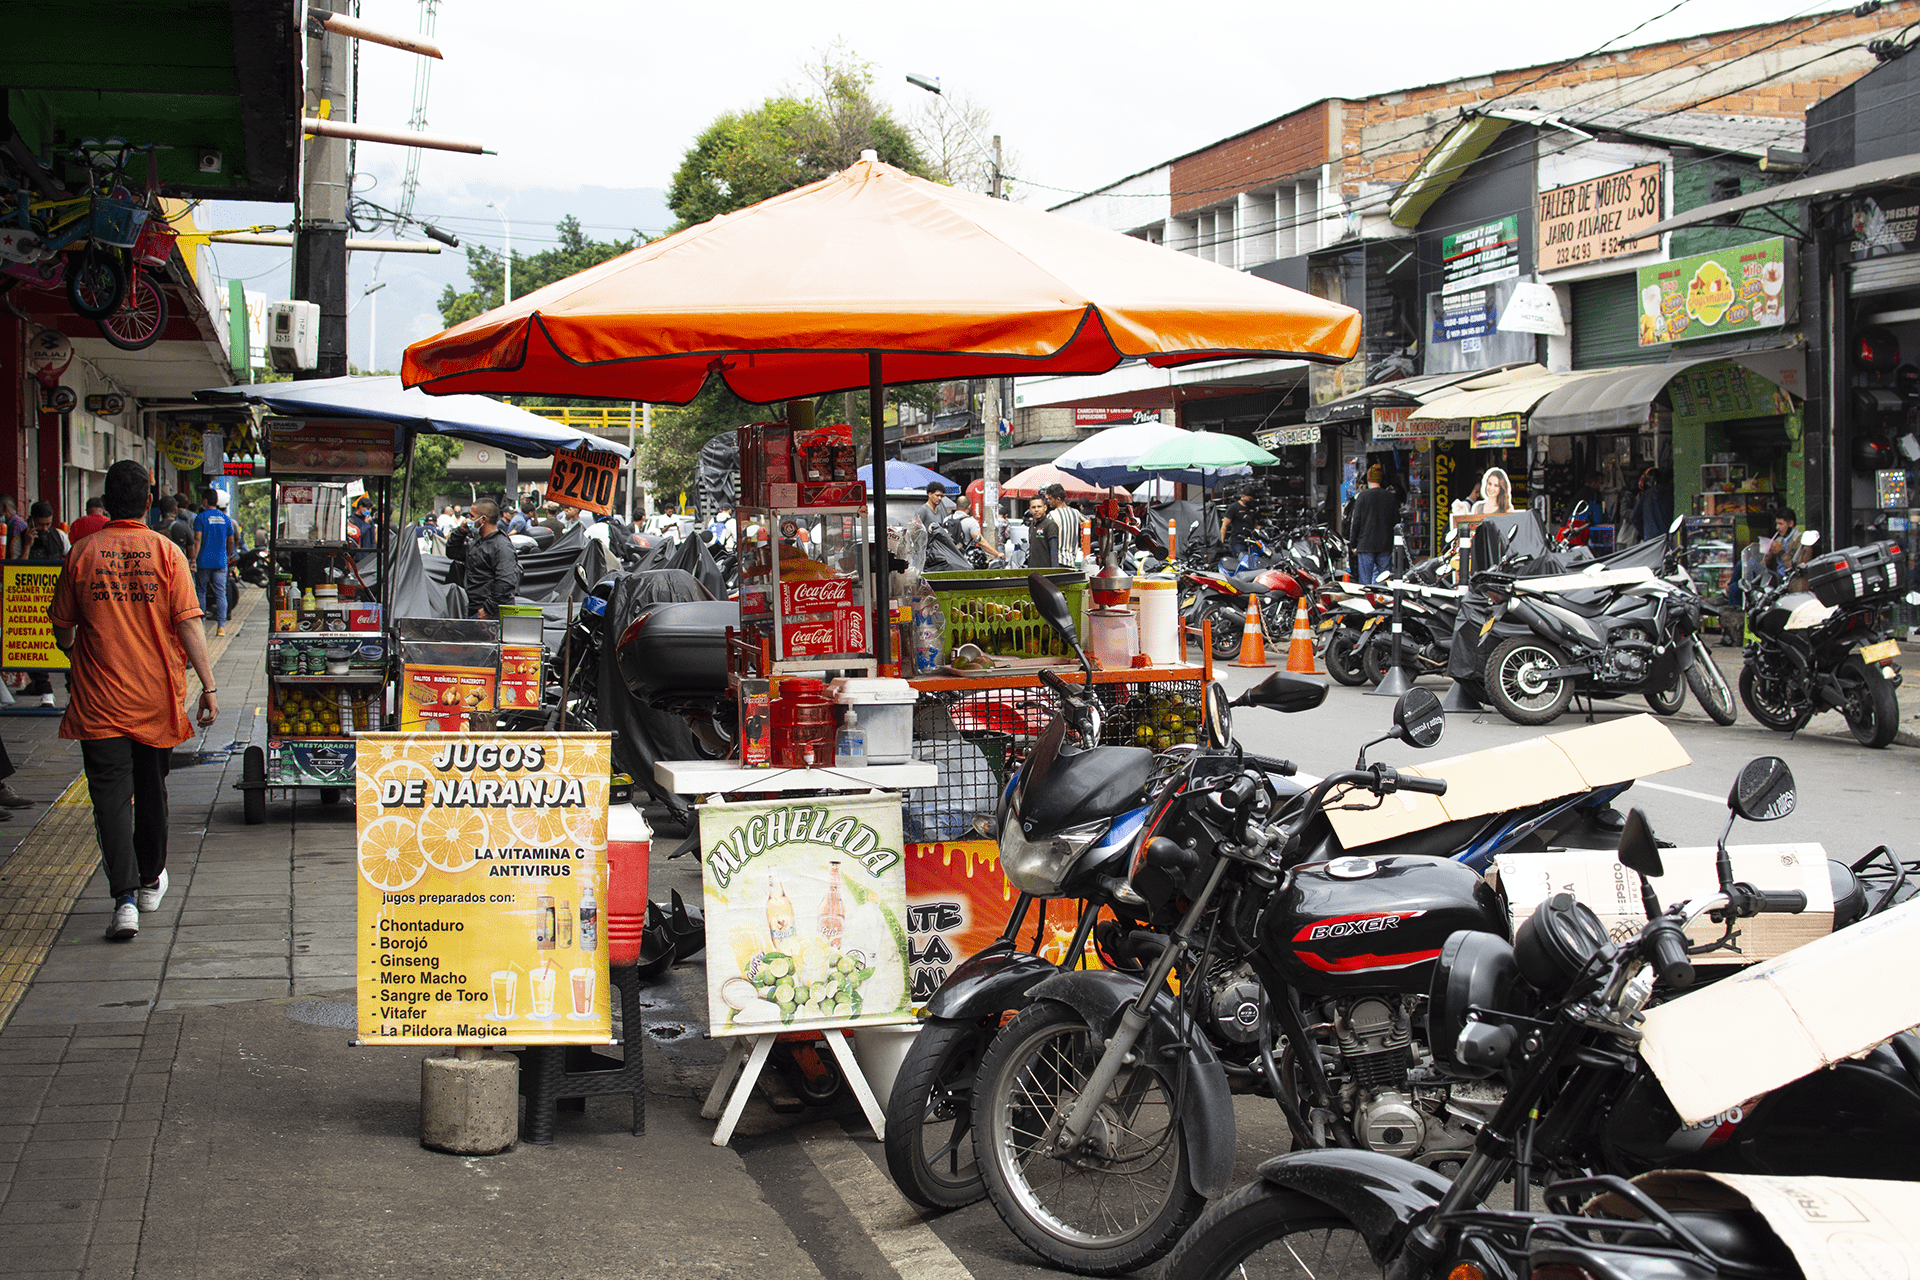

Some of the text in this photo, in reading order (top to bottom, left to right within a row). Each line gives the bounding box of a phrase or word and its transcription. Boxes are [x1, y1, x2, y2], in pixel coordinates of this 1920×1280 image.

[1540, 174, 1656, 222] TALLER DE MOTOS 38
[1546, 208, 1636, 246] JAIRO ALVAREZ LA
[1557, 248, 1569, 264] 232
[1582, 242, 1591, 259] 93
[1742, 263, 1763, 278] Milo
[1396, 423, 1409, 432] AL
[552, 459, 613, 506] $200
[100, 551, 151, 559] TAPIZADOS
[90, 581, 108, 590] Calle
[144, 583, 158, 591] 105
[794, 581, 849, 602] Coca-Cola
[92, 591, 155, 602] 300 721 00 62
[791, 629, 833, 645] Coca-Cola
[433, 743, 545, 771] JUGOS
[381, 779, 586, 808] DE NARANJA
[474, 848, 585, 860] LA VITAMINA C
[706, 806, 900, 888] MICHELADA
[489, 865, 570, 877] ANTIVIRUS
[382, 892, 515, 905] jugos preparados con:
[380, 919, 464, 932] Chontaduro
[1309, 916, 1400, 940] BOXER
[380, 936, 428, 952] Borojó
[380, 954, 439, 968] Ginseng
[380, 972, 415, 984] Mero
[420, 972, 467, 984] Macho
[380, 990, 430, 1004] Sangre
[435, 990, 452, 1001] de
[457, 990, 488, 1001] Toro
[380, 1007, 426, 1019] Vitafer
[380, 1025, 397, 1037] La
[402, 1024, 451, 1037] Pildora
[457, 1024, 507, 1040] Magica
